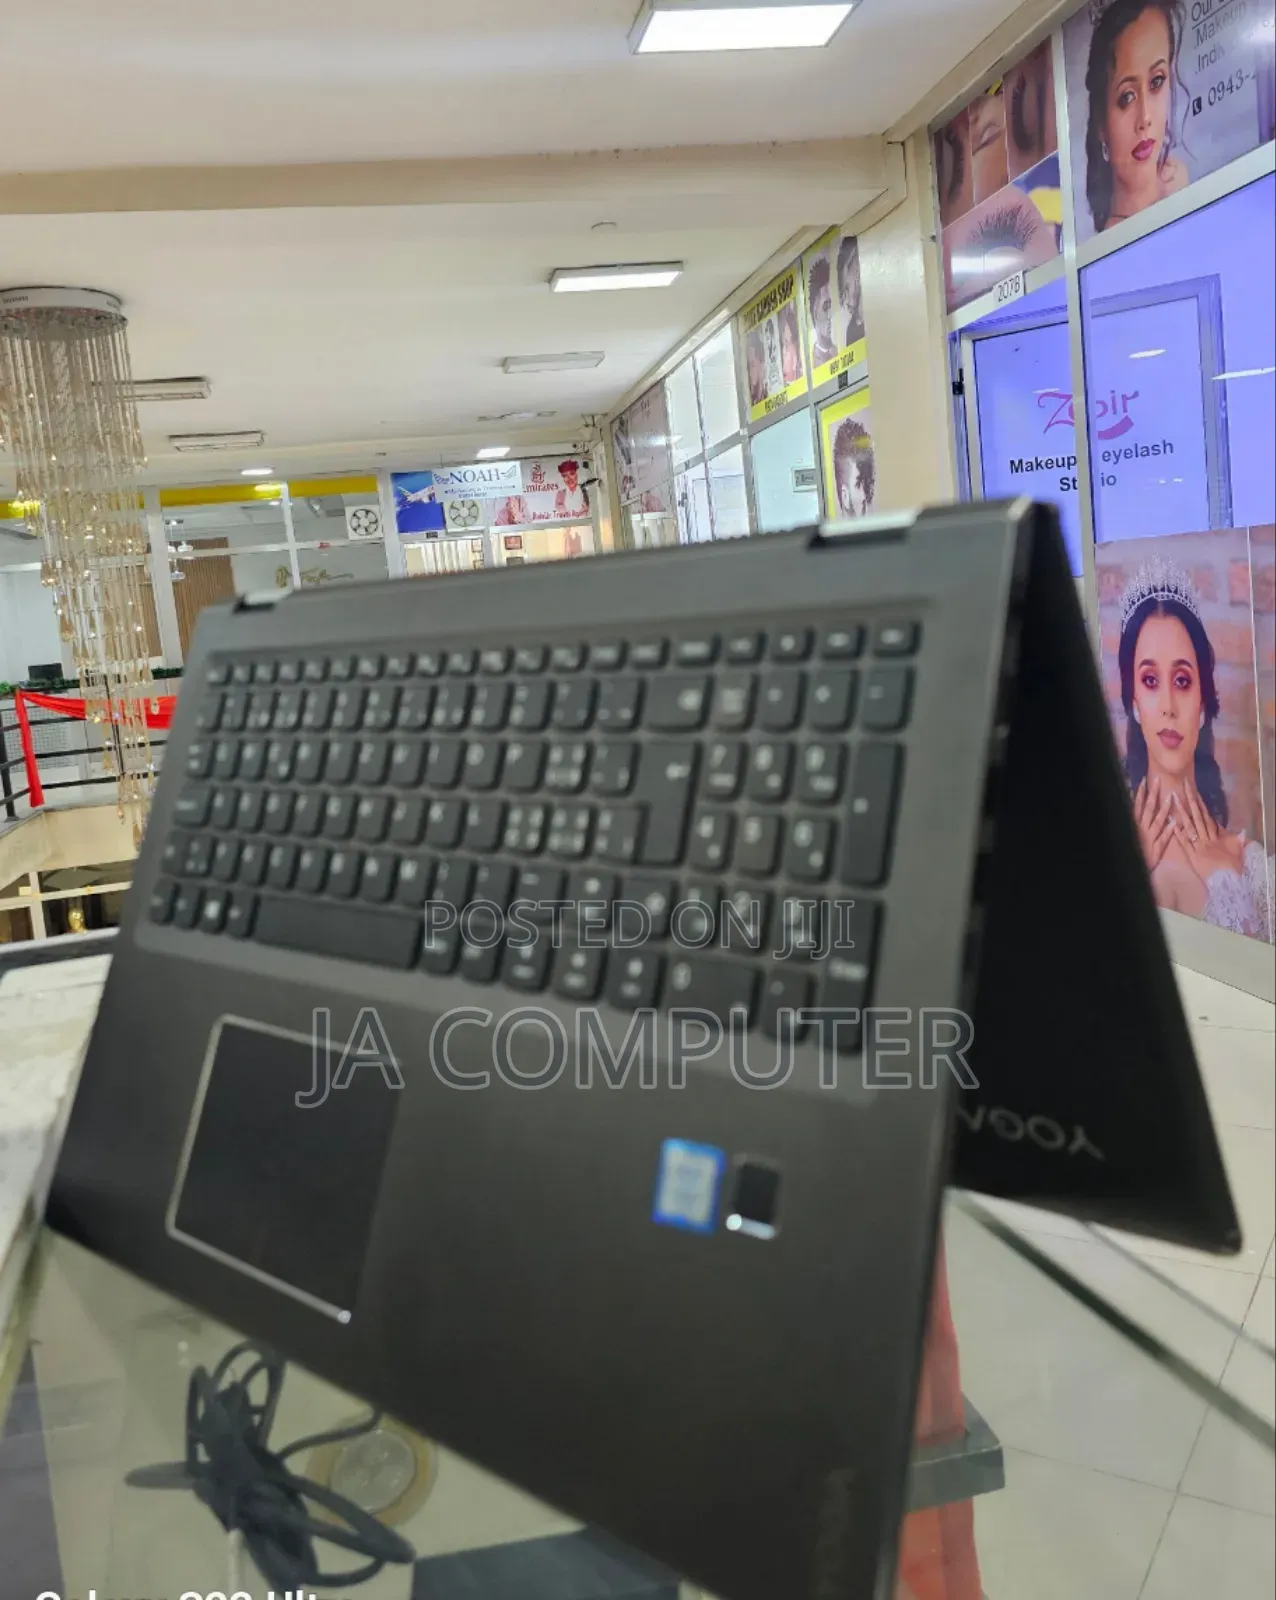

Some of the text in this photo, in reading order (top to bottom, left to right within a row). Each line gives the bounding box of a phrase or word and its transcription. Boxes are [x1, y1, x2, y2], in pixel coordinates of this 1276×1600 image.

[1009, 439, 1174, 475] Makeup eyelash
[449, 468, 501, 484] NOAH
[1059, 472, 1117, 492] Stio
